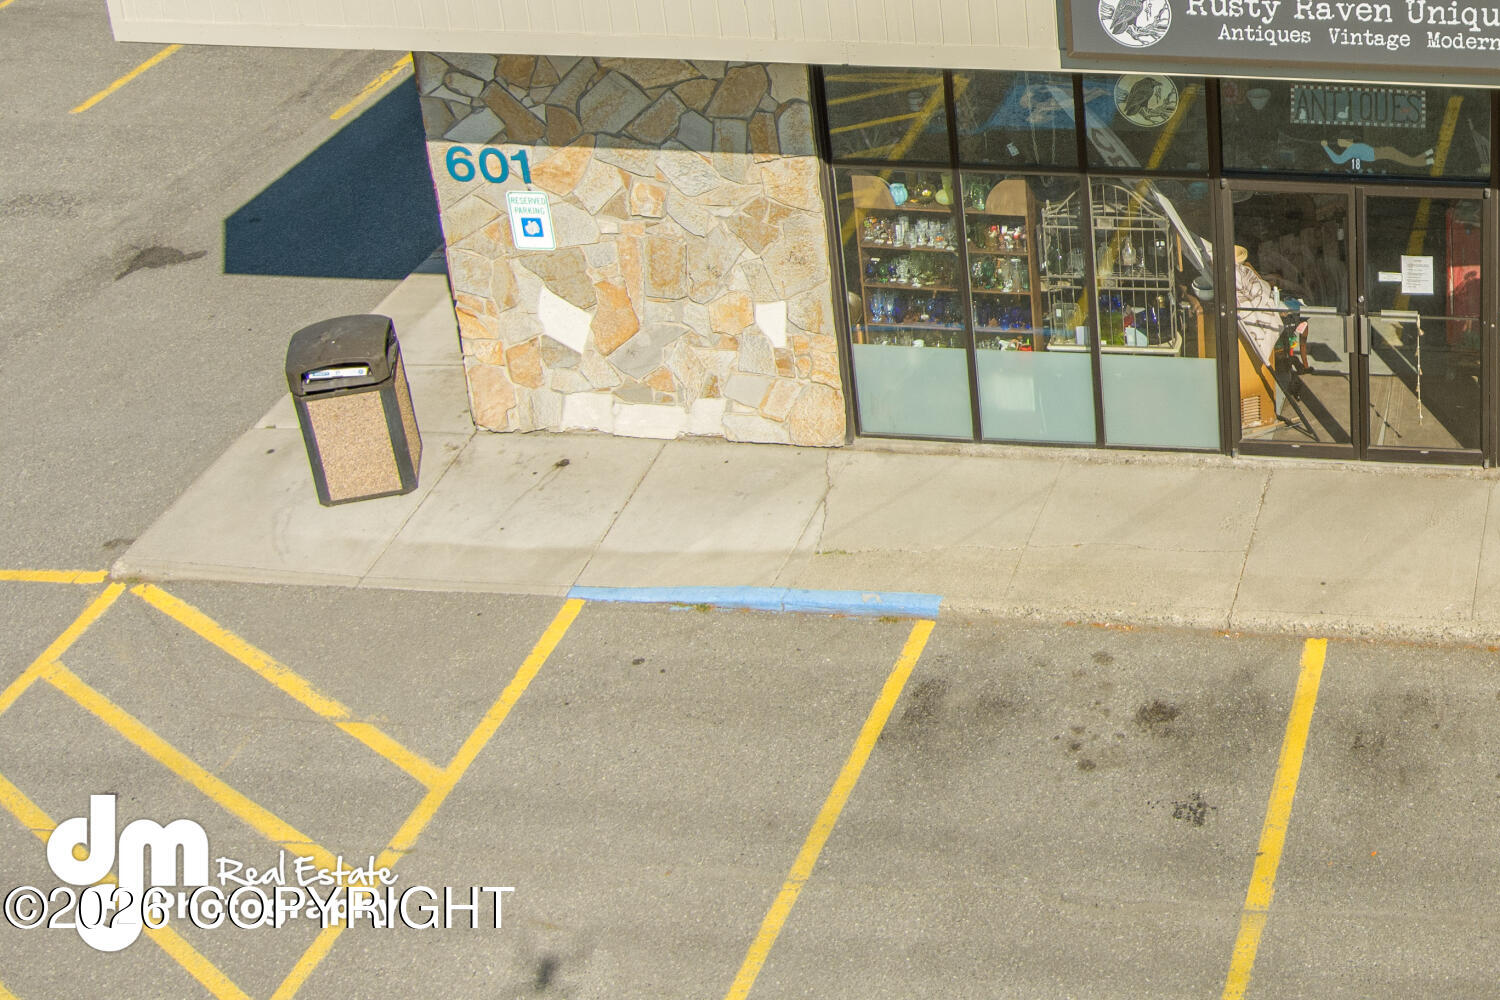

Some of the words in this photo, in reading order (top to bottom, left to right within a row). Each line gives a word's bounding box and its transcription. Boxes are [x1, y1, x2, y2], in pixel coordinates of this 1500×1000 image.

[1218, 23, 1312, 46] Antiques
[1329, 28, 1411, 50] Vintage
[1296, 89, 1422, 123] ANTIQUES
[446, 146, 531, 184] 601
[1351, 158, 1361, 170] 18
[510, 197, 546, 205] RESERVED
[514, 207, 545, 215] PARKING
